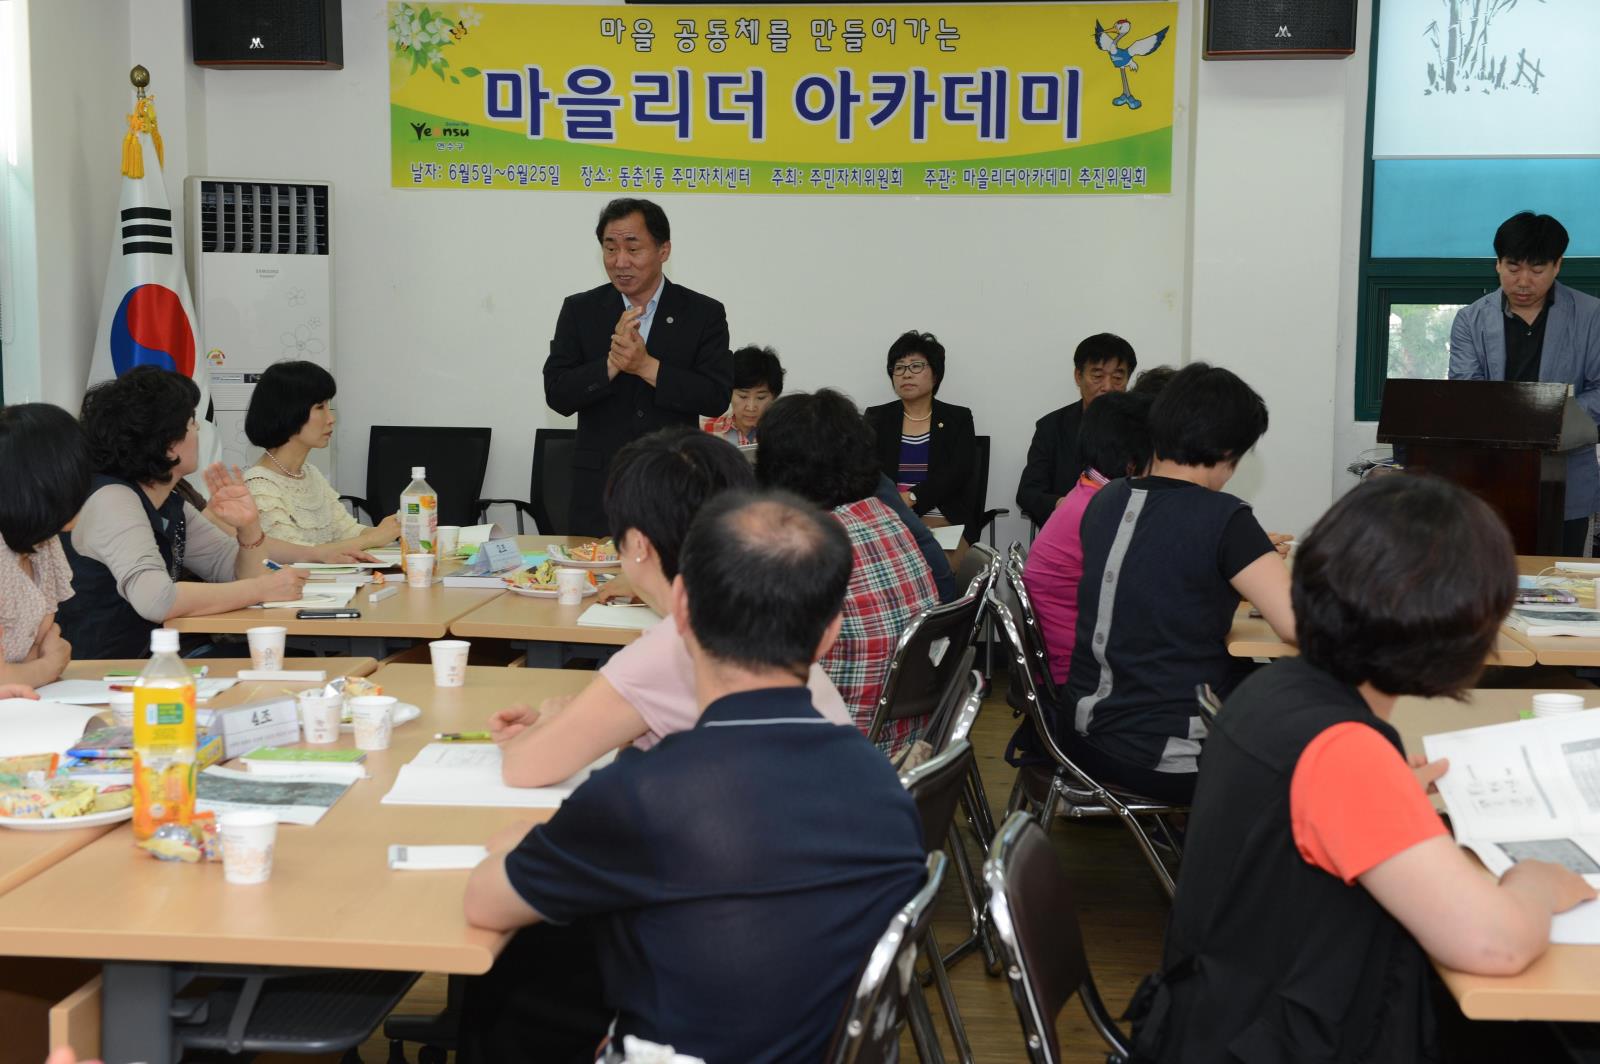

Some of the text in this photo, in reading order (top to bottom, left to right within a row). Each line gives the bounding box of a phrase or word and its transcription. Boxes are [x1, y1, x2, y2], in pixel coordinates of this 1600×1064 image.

[601, 18, 961, 53] 마을 공동체를 만들어가는
[484, 65, 1081, 142] 마을리더 아카데미
[410, 122, 469, 140] Yeonsu
[411, 162, 442, 183] 날자:
[580, 166, 612, 187] 장소:
[618, 166, 665, 188] 동춘1동
[672, 167, 751, 189] 주민자치센터
[771, 168, 802, 187] 주최:
[810, 168, 902, 189] 주민자치위원회
[925, 168, 956, 190] 주관:
[963, 168, 1072, 189] 마을리더아카데미
[1079, 167, 1146, 189] 추진위원회
